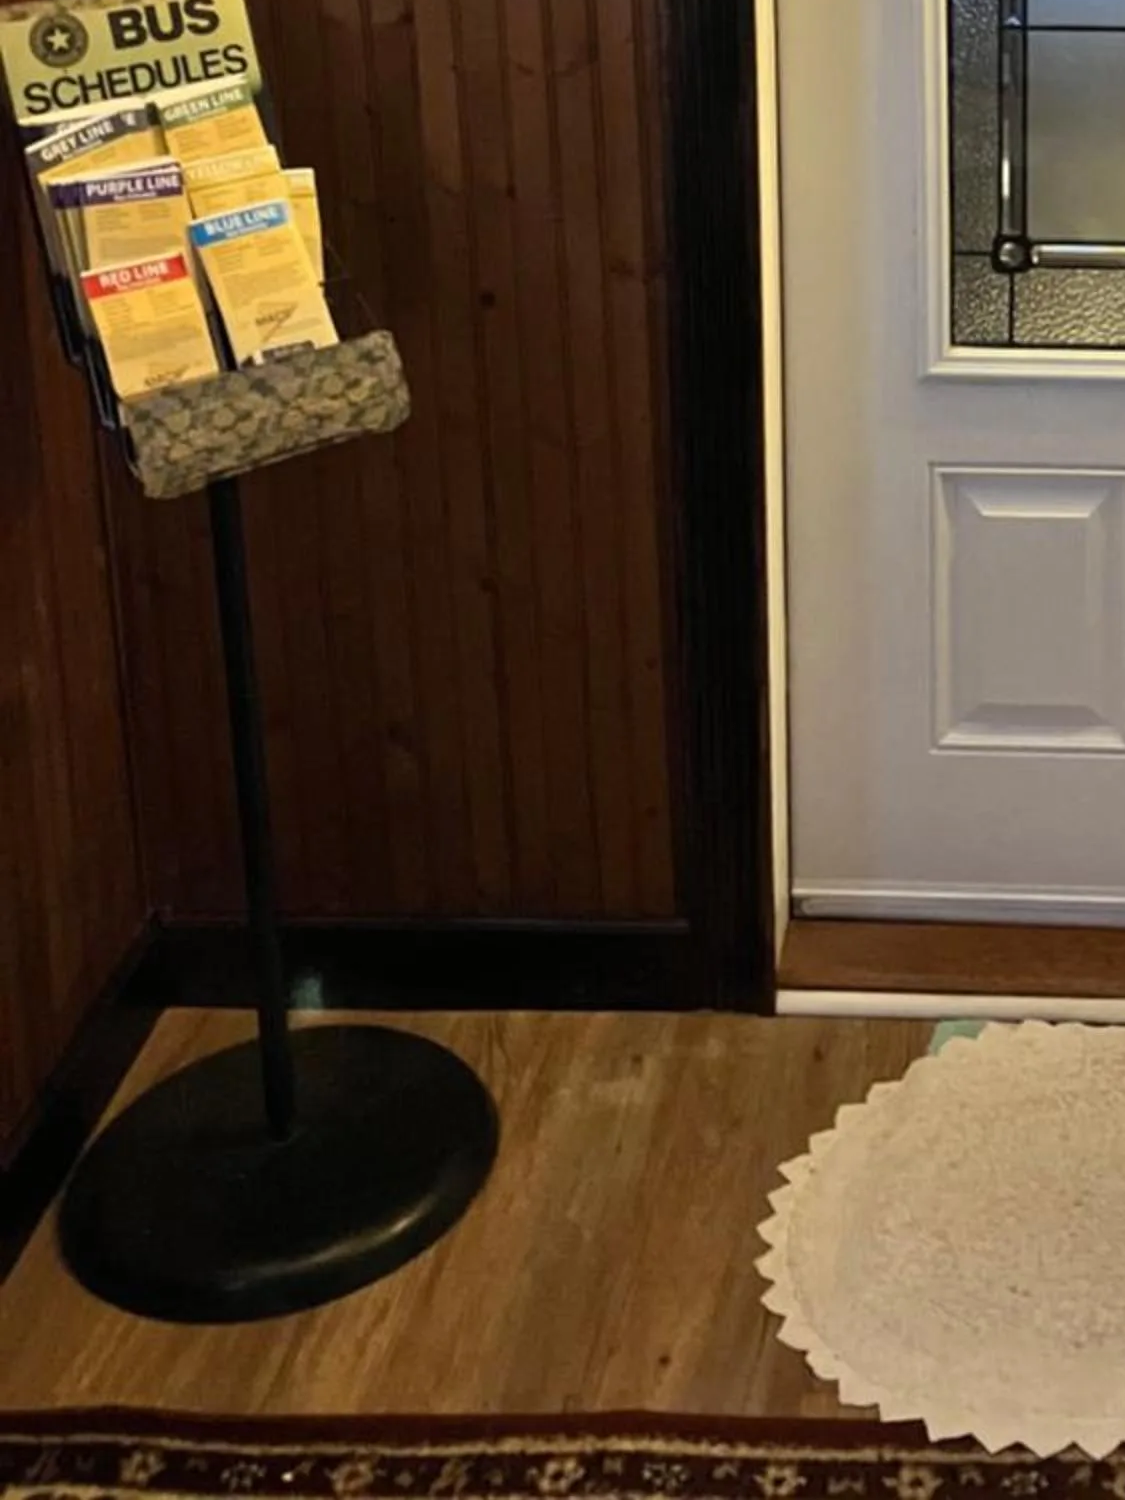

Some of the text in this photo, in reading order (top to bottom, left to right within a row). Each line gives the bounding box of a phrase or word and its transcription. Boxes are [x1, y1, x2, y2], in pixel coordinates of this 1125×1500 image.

[23, 42, 249, 116] SCHEDULES
[164, 99, 210, 122] GREEN
[212, 88, 244, 108] LINE
[40, 134, 79, 162] GREY
[78, 119, 114, 144] LINE
[86, 177, 144, 197] PURPLE
[146, 174, 179, 190] LINE
[203, 214, 242, 236] BLUE
[243, 205, 279, 225] LINE
[99, 270, 131, 290] RED
[132, 261, 169, 280] LINE
